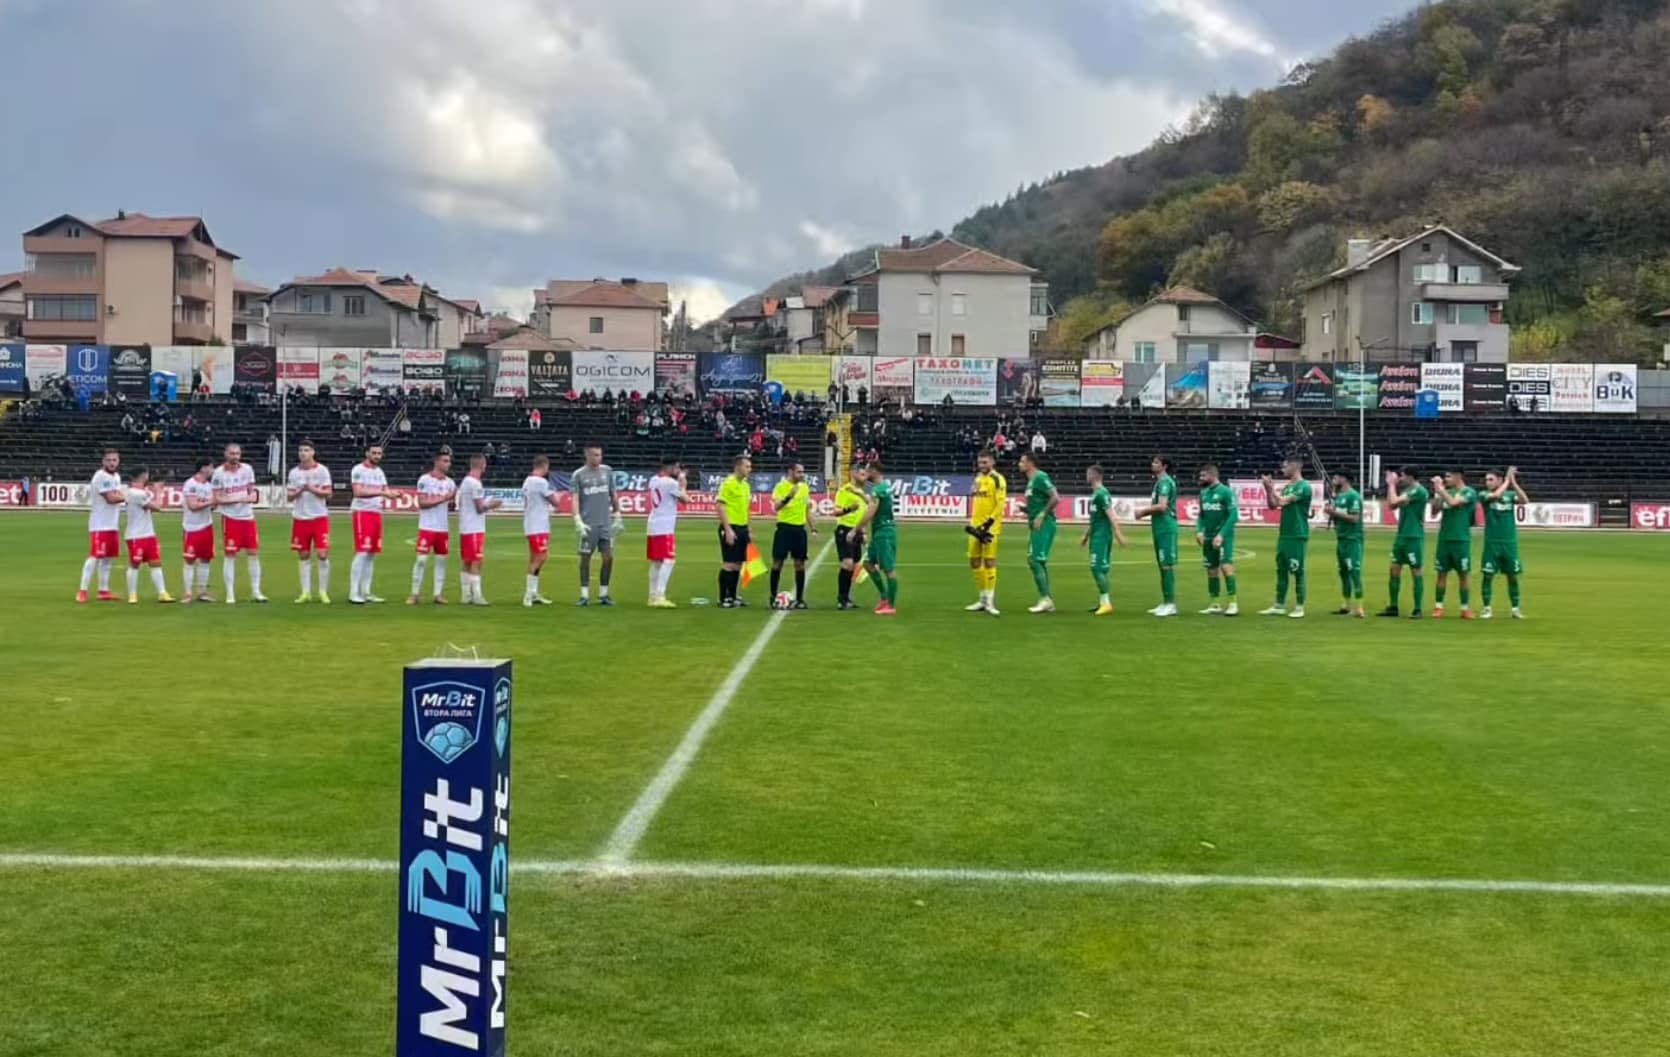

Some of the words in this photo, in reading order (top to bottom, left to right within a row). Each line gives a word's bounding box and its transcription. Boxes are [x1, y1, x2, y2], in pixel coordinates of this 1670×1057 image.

[1510, 367, 1548, 378] DIES
[1510, 382, 1548, 394] DIES
[890, 475, 952, 496] MrBit
[40, 486, 68, 502] 100
[906, 495, 961, 507] MITOV
[421, 690, 476, 707] MrBit
[424, 709, 450, 717] ВТОРА
[450, 709, 473, 717] ЛИГА
[407, 777, 483, 1050] MrBit
